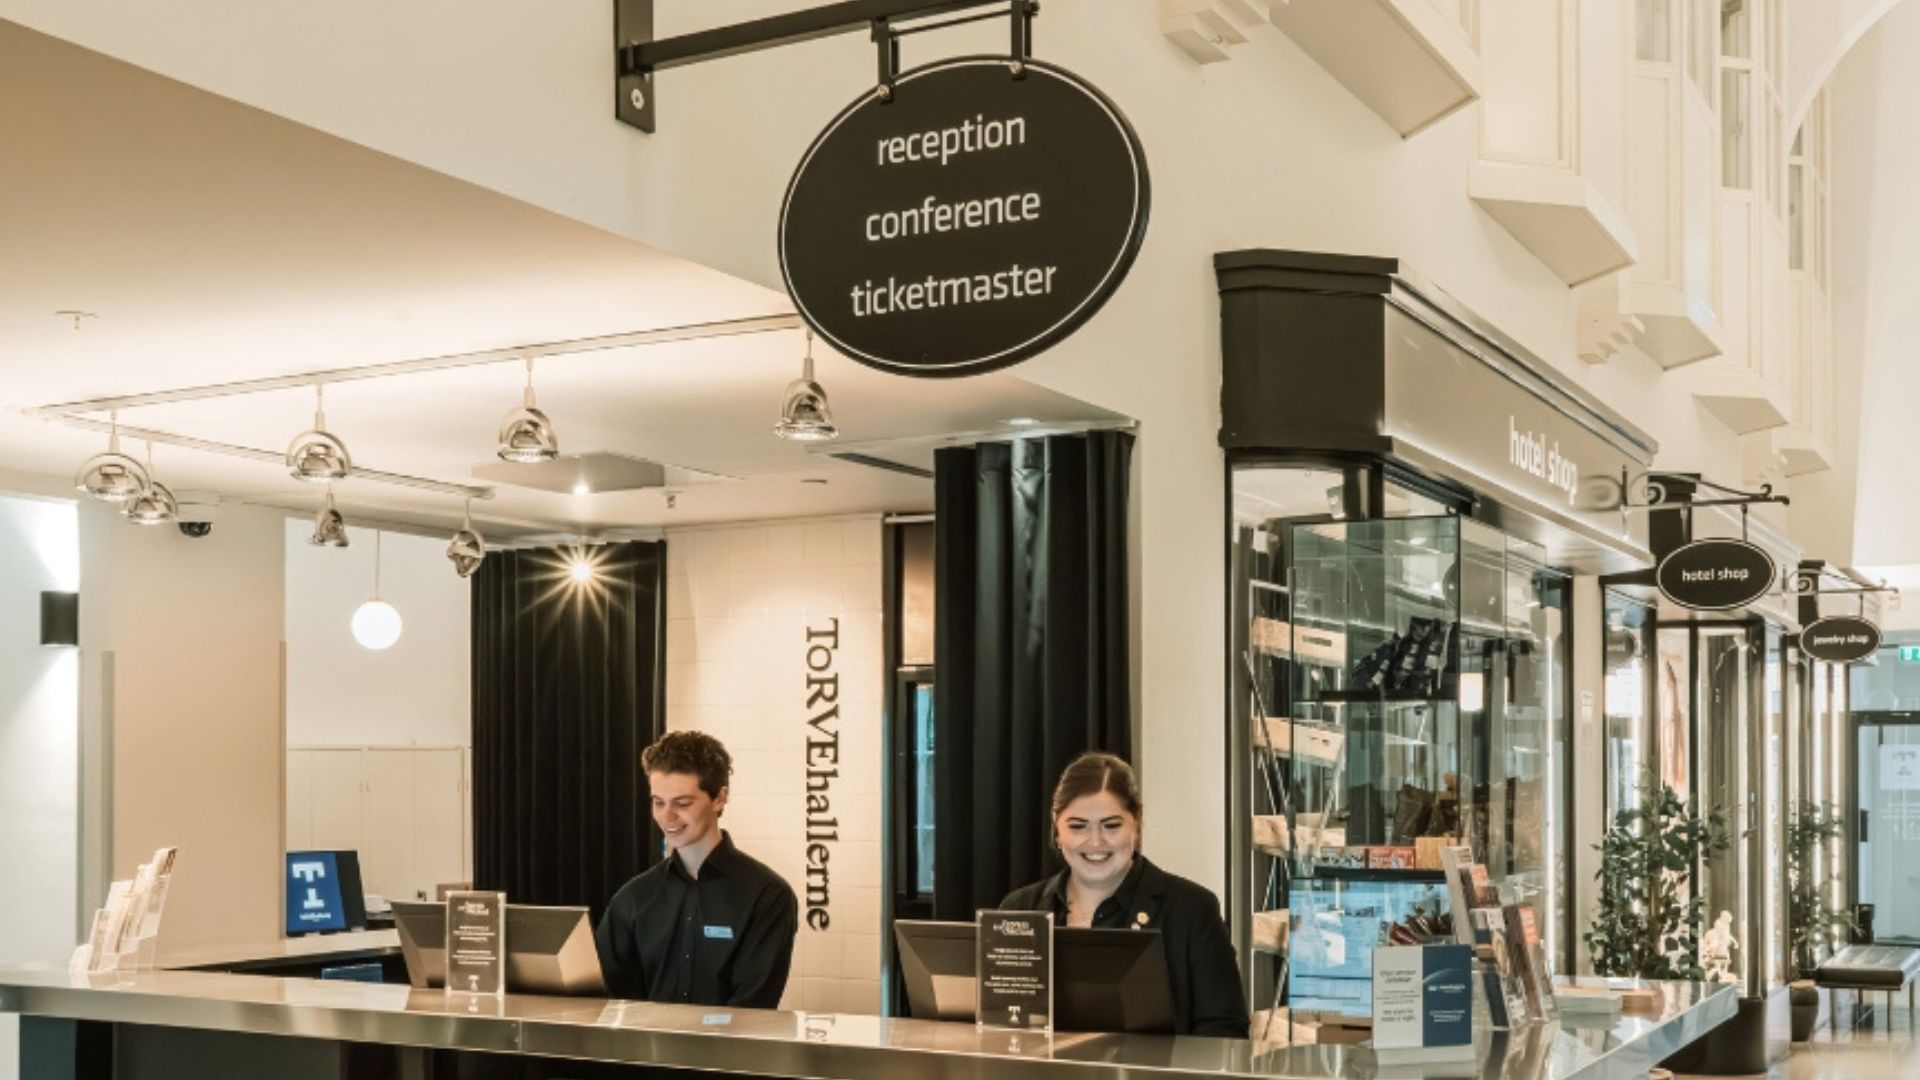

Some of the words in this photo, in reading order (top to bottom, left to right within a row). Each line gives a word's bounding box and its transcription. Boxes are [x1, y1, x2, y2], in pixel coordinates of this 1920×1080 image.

[877, 113, 1026, 166] reception
[865, 191, 1041, 241] conference
[850, 264, 1057, 317] ticketmaster
[1509, 414, 1545, 479] hotel
[1548, 440, 1578, 506] shop
[1682, 568, 1715, 582] hotel
[1717, 566, 1749, 582] shop
[1813, 634, 1846, 647] jewelry
[1847, 633, 1869, 646] shop
